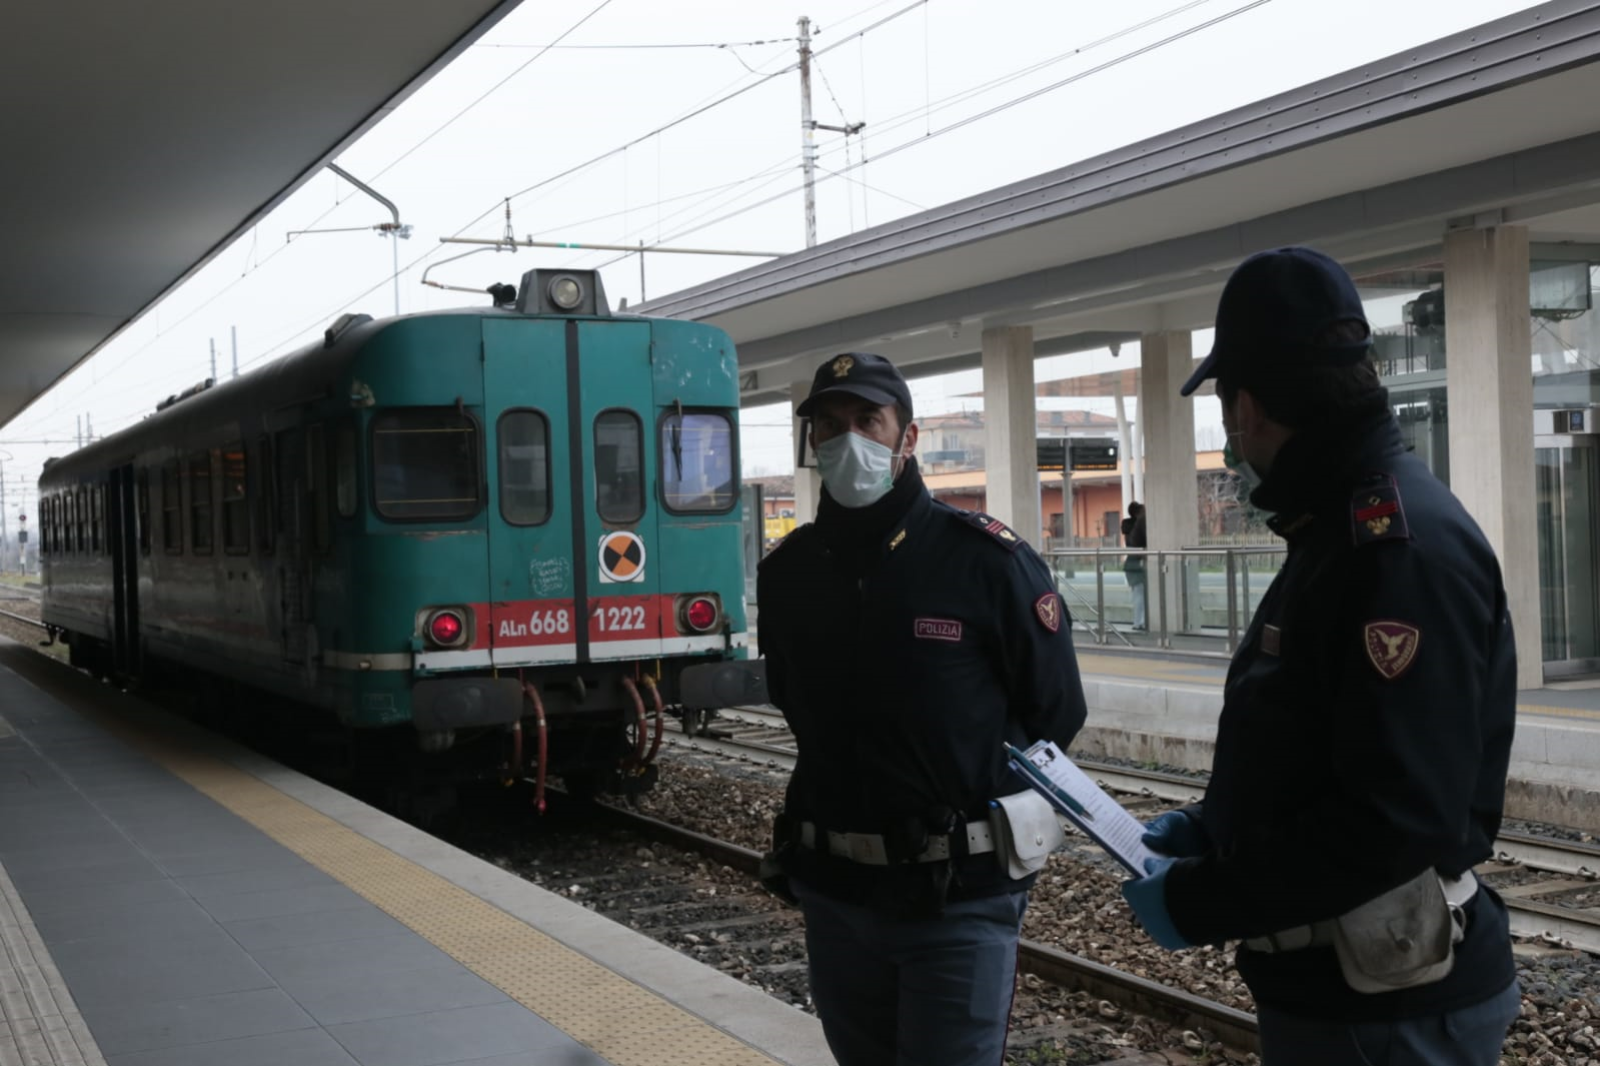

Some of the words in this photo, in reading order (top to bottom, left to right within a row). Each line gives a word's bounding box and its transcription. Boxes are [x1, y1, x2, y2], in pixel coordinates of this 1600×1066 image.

[499, 620, 527, 637] ALn
[530, 609, 569, 635] 668
[595, 606, 646, 631] 1222
[919, 622, 958, 636] POLIZIA
